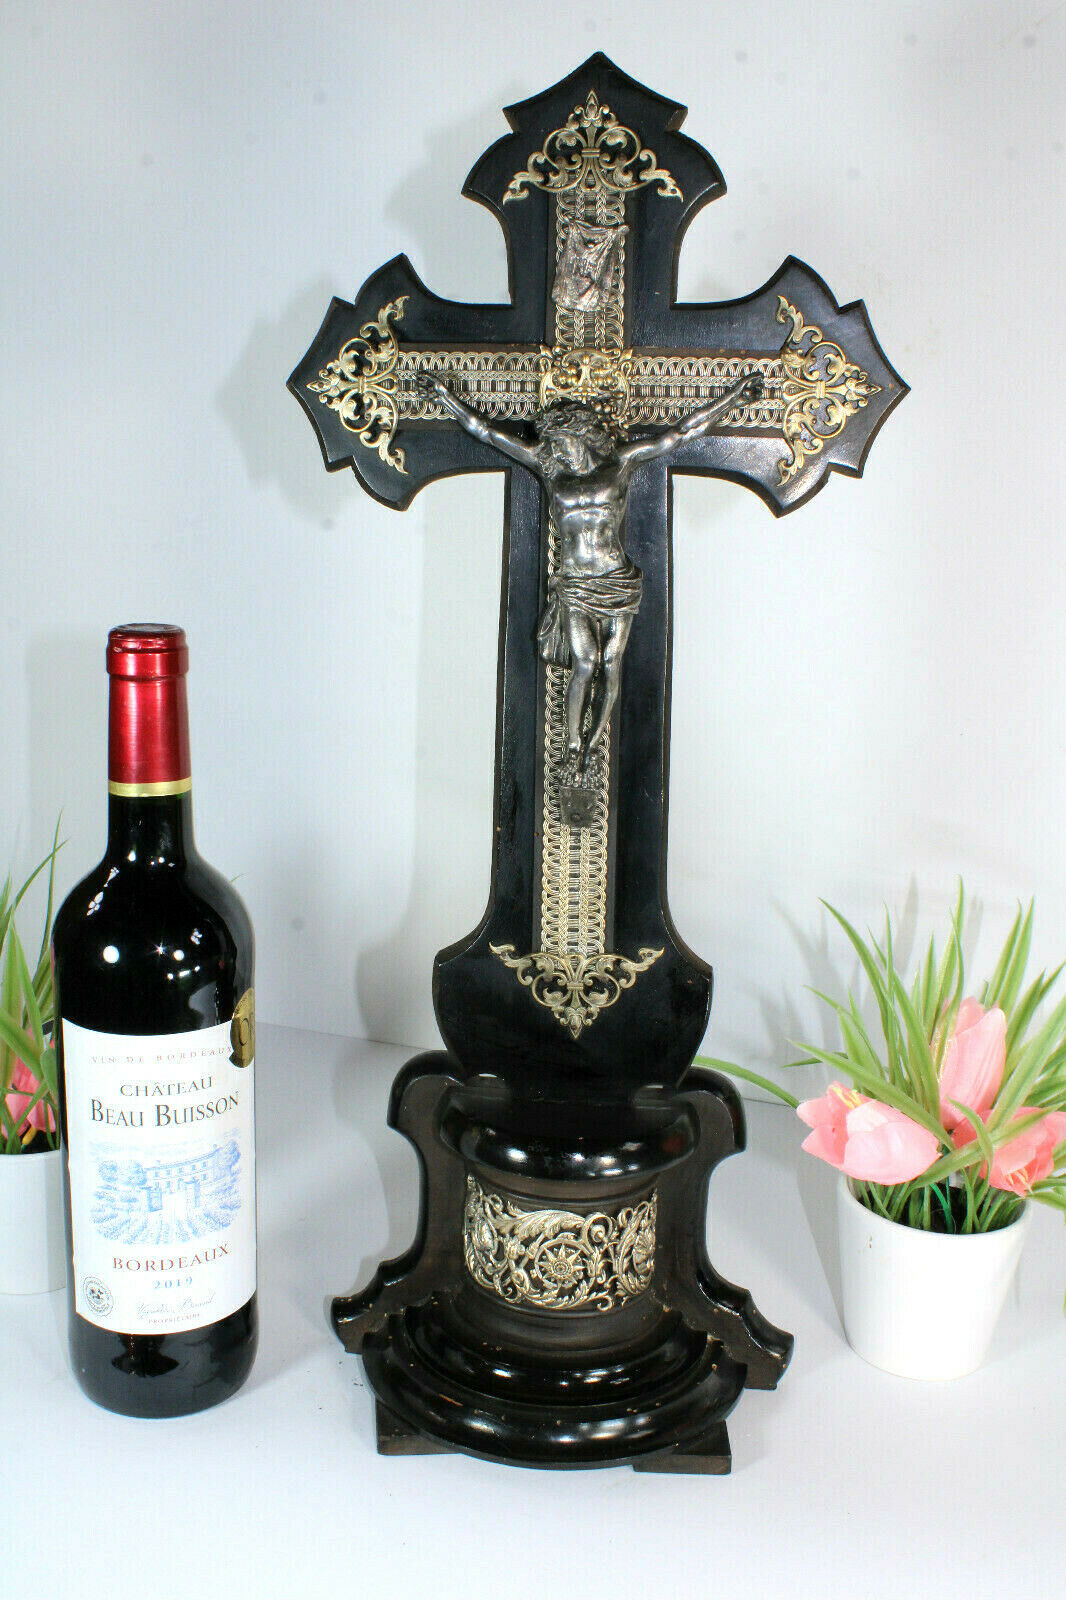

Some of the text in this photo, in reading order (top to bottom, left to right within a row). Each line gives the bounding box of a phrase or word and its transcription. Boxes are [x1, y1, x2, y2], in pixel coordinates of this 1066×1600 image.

[91, 1047, 232, 1064] VIN DE BORDEAUX
[120, 1076, 213, 1097] CHÂTEAU
[91, 1091, 240, 1127] BEAU BUISSON
[112, 1243, 229, 1272] BORDEAUX
[153, 1276, 193, 1289] 2019
